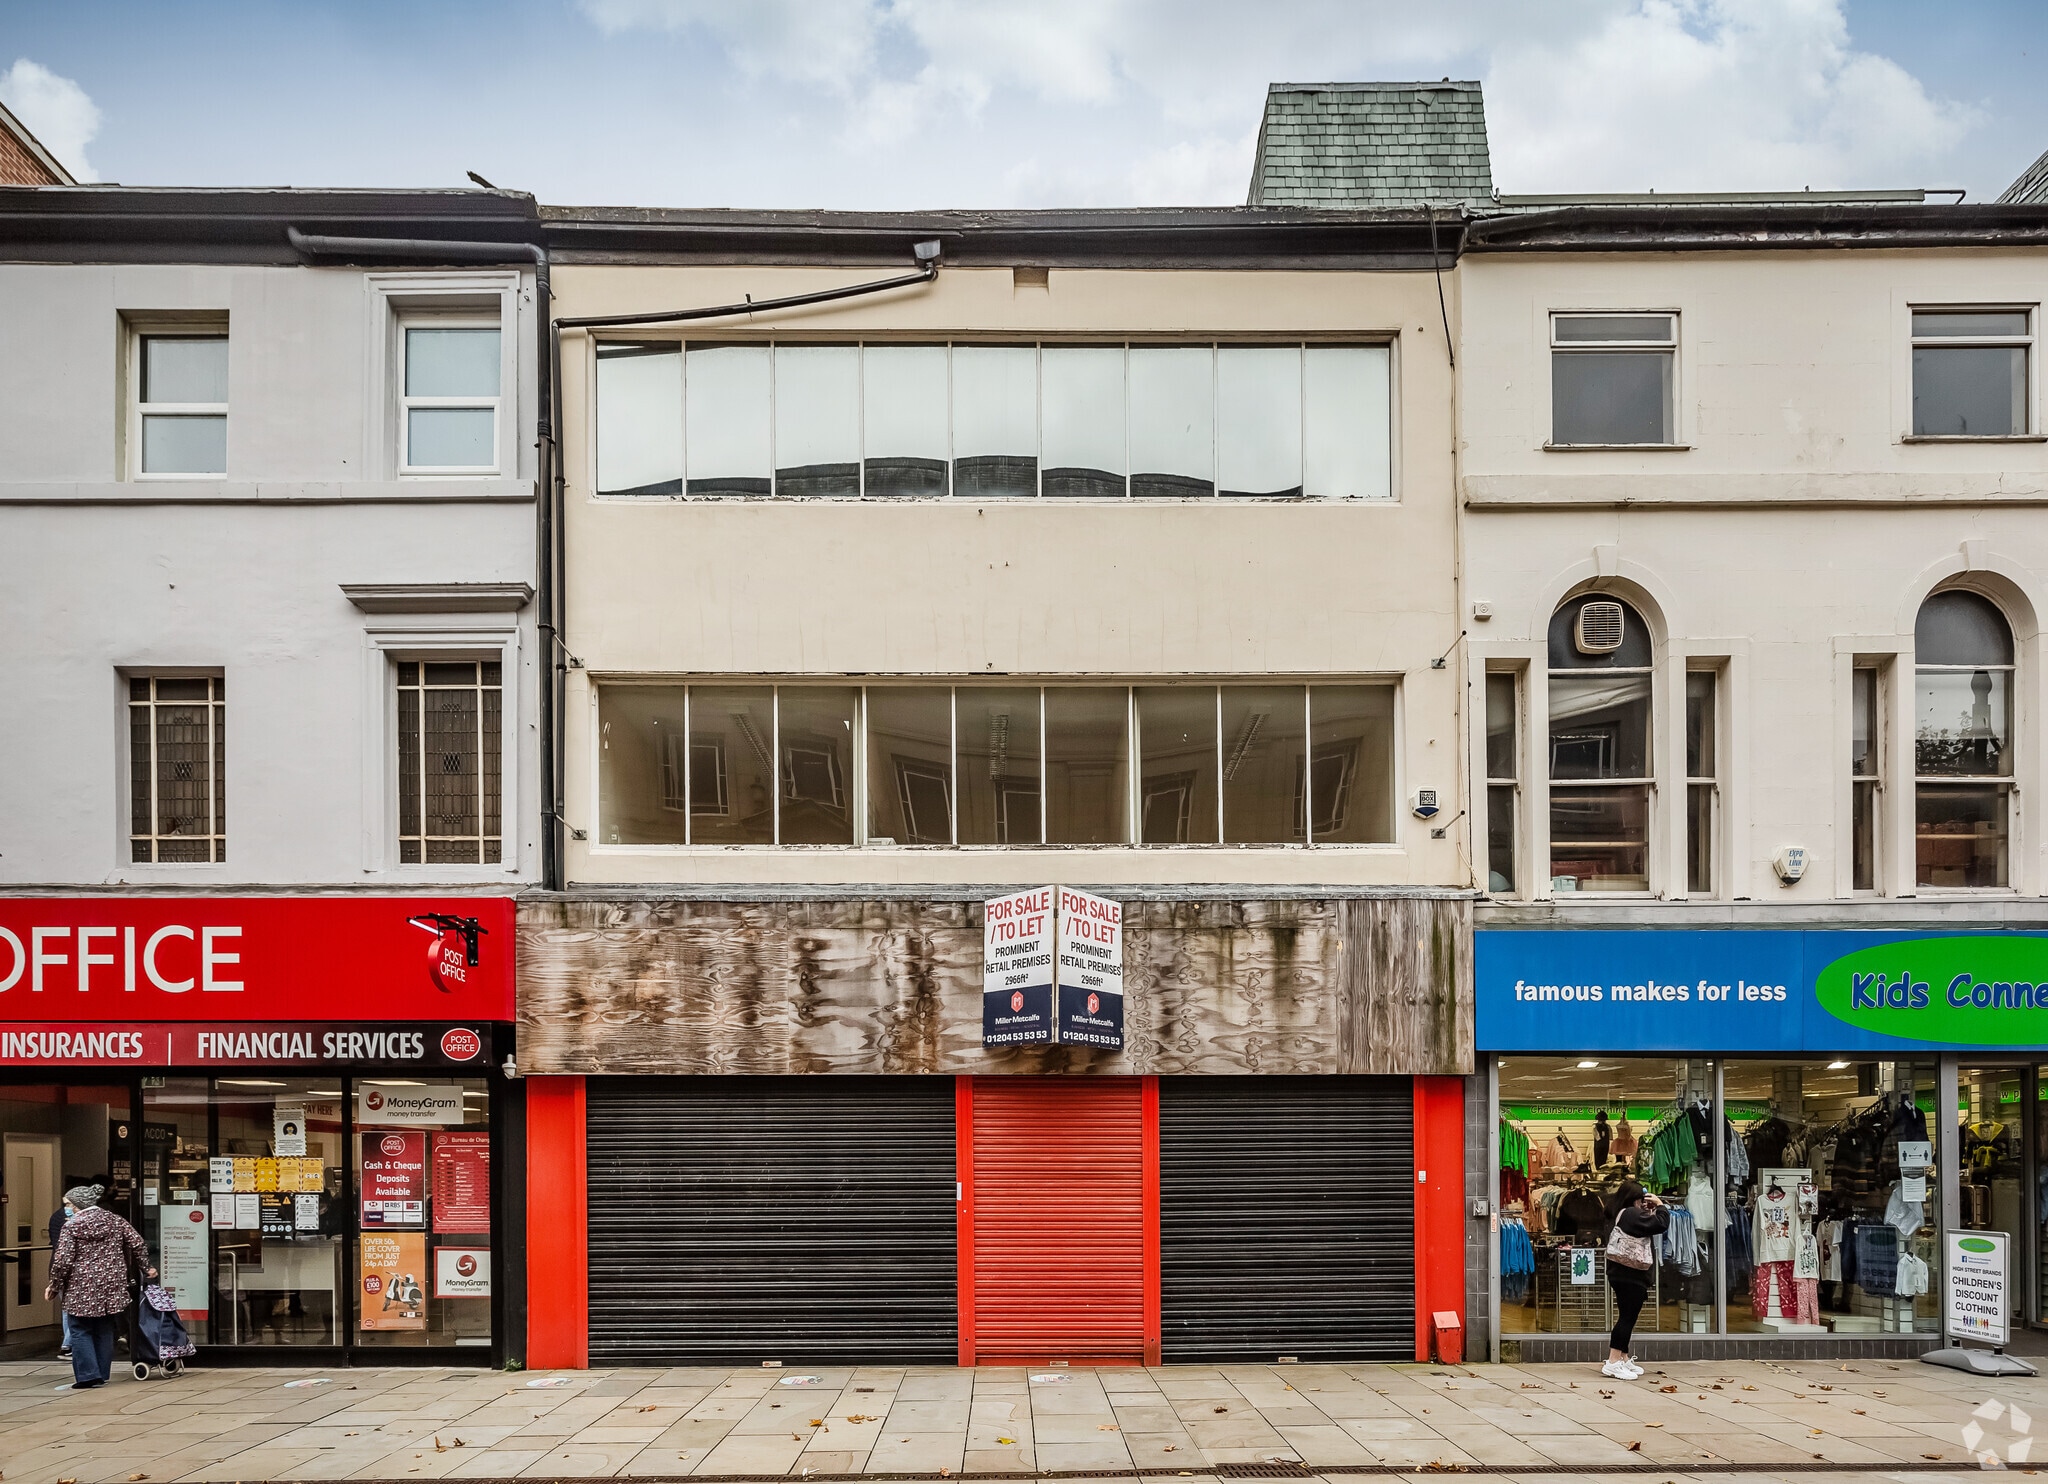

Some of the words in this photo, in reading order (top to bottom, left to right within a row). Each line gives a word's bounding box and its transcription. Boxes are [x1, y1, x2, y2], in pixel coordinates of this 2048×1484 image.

[987, 900, 1012, 922] FOR
[1015, 891, 1050, 916] SALE
[1062, 892, 1087, 916] FOR
[1090, 901, 1119, 924] SALE
[1019, 915, 1044, 937] LET
[1094, 925, 1115, 944] LET
[444, 948, 463, 966] POST
[995, 940, 1040, 958] PROMINENT
[1071, 941, 1112, 960] PROMINENT
[985, 960, 1010, 974] RETAIL
[1012, 954, 1050, 970] PREMISES
[1060, 954, 1086, 969] RETAIL
[1088, 961, 1121, 976] PREMISES
[440, 963, 466, 982] OFFICE
[1515, 980, 1603, 1001] famous
[1611, 980, 1690, 1001] makes
[1697, 980, 1731, 1001] for
[1738, 980, 1787, 1001] less
[1852, 971, 1930, 1010] Kids
[1946, 972, 2048, 1010] Conne
[450, 1035, 472, 1044] POST
[987, 1033, 1012, 1043] 01204
[1012, 1032, 1023, 1041] 53
[1024, 1031, 1035, 1040] 53
[1036, 1030, 1047, 1039] 53
[1063, 1031, 1089, 1042] 01204
[1089, 1034, 1099, 1043] 53
[1100, 1035, 1110, 1044] 53
[1110, 1036, 1120, 1045] 53
[1, 1032, 143, 1059] INSURANCES
[198, 1032, 317, 1059] FINANCIAL
[323, 1032, 425, 1060] SERVICES
[446, 1044, 475, 1052] OFFICE
[317, 1105, 333, 1116] HERE
[387, 1097, 456, 1110] MoneyGram
[1530, 1104, 1583, 1115] Chainstore
[364, 1161, 382, 1169] Cash
[385, 1161, 391, 1169] &
[393, 1161, 421, 1171] Cheque
[376, 1174, 410, 1184] Deposits
[375, 1187, 410, 1195] Available
[364, 1260, 376, 1268] 24p
[1952, 1276, 2002, 1290] CHILDREN'S
[1956, 1289, 1998, 1303] DISCOUNT
[1955, 1301, 1998, 1316] CLOTHING
